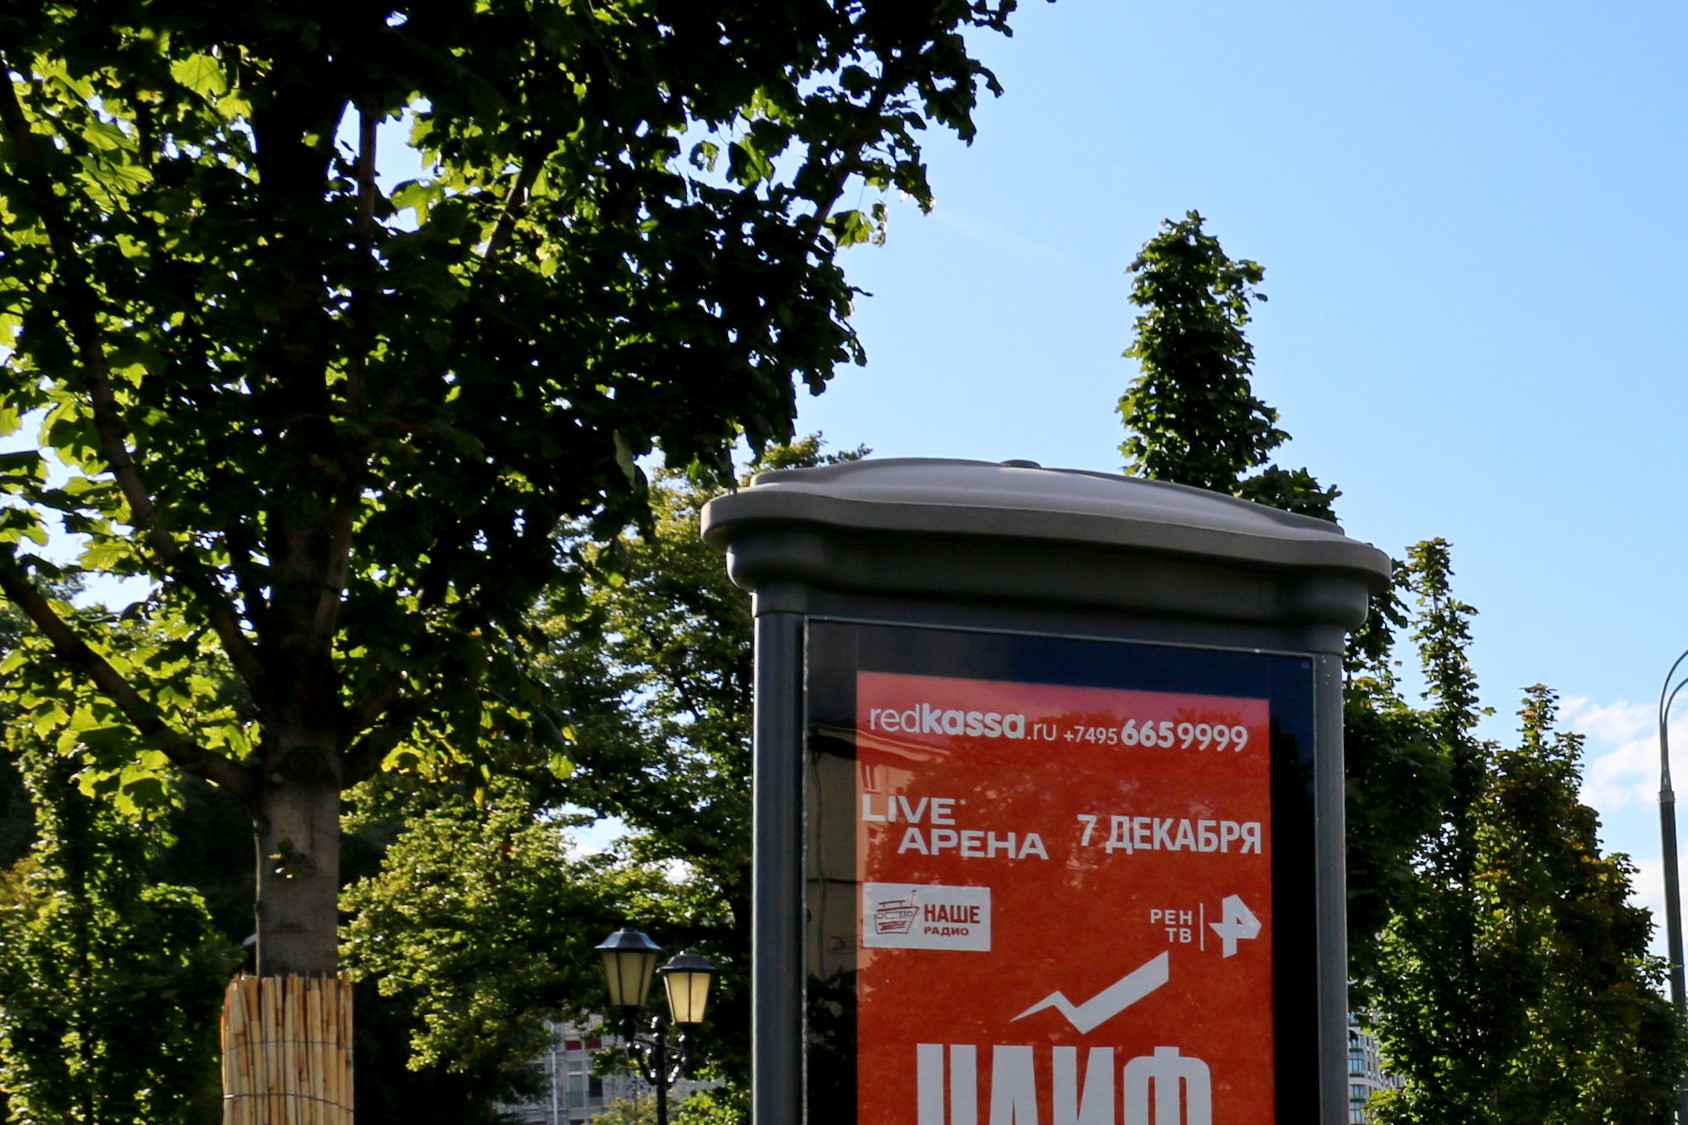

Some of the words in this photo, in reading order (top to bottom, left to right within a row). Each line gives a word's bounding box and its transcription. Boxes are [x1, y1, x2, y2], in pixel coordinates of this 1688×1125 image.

[870, 703, 1057, 741] redkassa.ru
[1063, 725, 1118, 745] +7495
[898, 827, 1049, 860] АРЕНА
[1077, 814, 1097, 846] 7
[1105, 815, 1261, 854] ДЕКАБРЯ
[924, 903, 980, 924] НАШЕ
[1150, 908, 1193, 925] РЕН
[924, 926, 969, 936] РАДИО
[1165, 927, 1192, 943] ТВ
